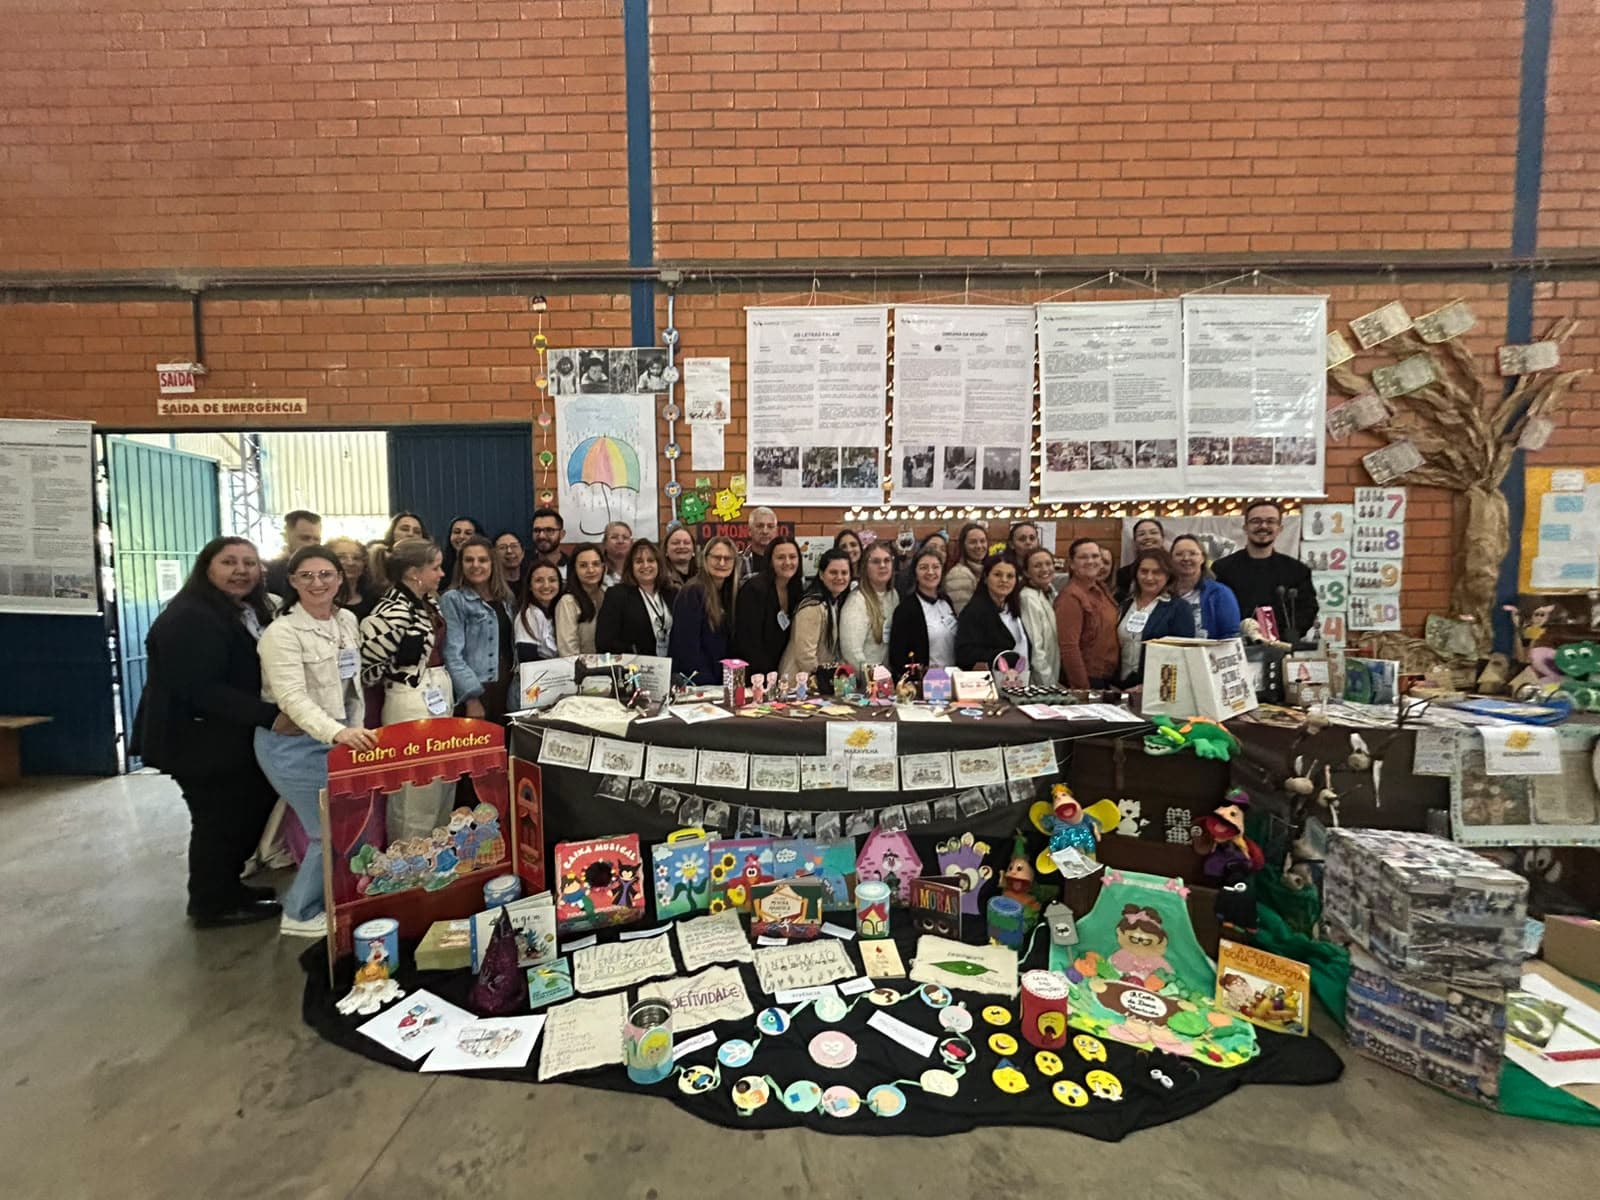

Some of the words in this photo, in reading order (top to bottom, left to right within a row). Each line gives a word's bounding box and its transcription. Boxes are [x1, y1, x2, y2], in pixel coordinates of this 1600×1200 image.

[203, 403, 219, 413] DE
[1387, 494, 1404, 519] 7
[702, 524, 711, 538] O
[716, 524, 790, 538] MONO
[1330, 511, 1345, 534] 1
[1384, 530, 1400, 551] 8
[1328, 548, 1347, 570] 2
[1381, 564, 1398, 587] 9
[1326, 581, 1345, 607] 3
[1373, 604, 1397, 623] 10
[1323, 616, 1343, 642] 4
[349, 746, 397, 764] Teatro
[403, 742, 420, 756] de
[426, 733, 491, 753] Fantoches
[563, 845, 593, 869] CAIXA
[594, 843, 637, 861] MUSICAL
[911, 886, 958, 916] AMORAS
